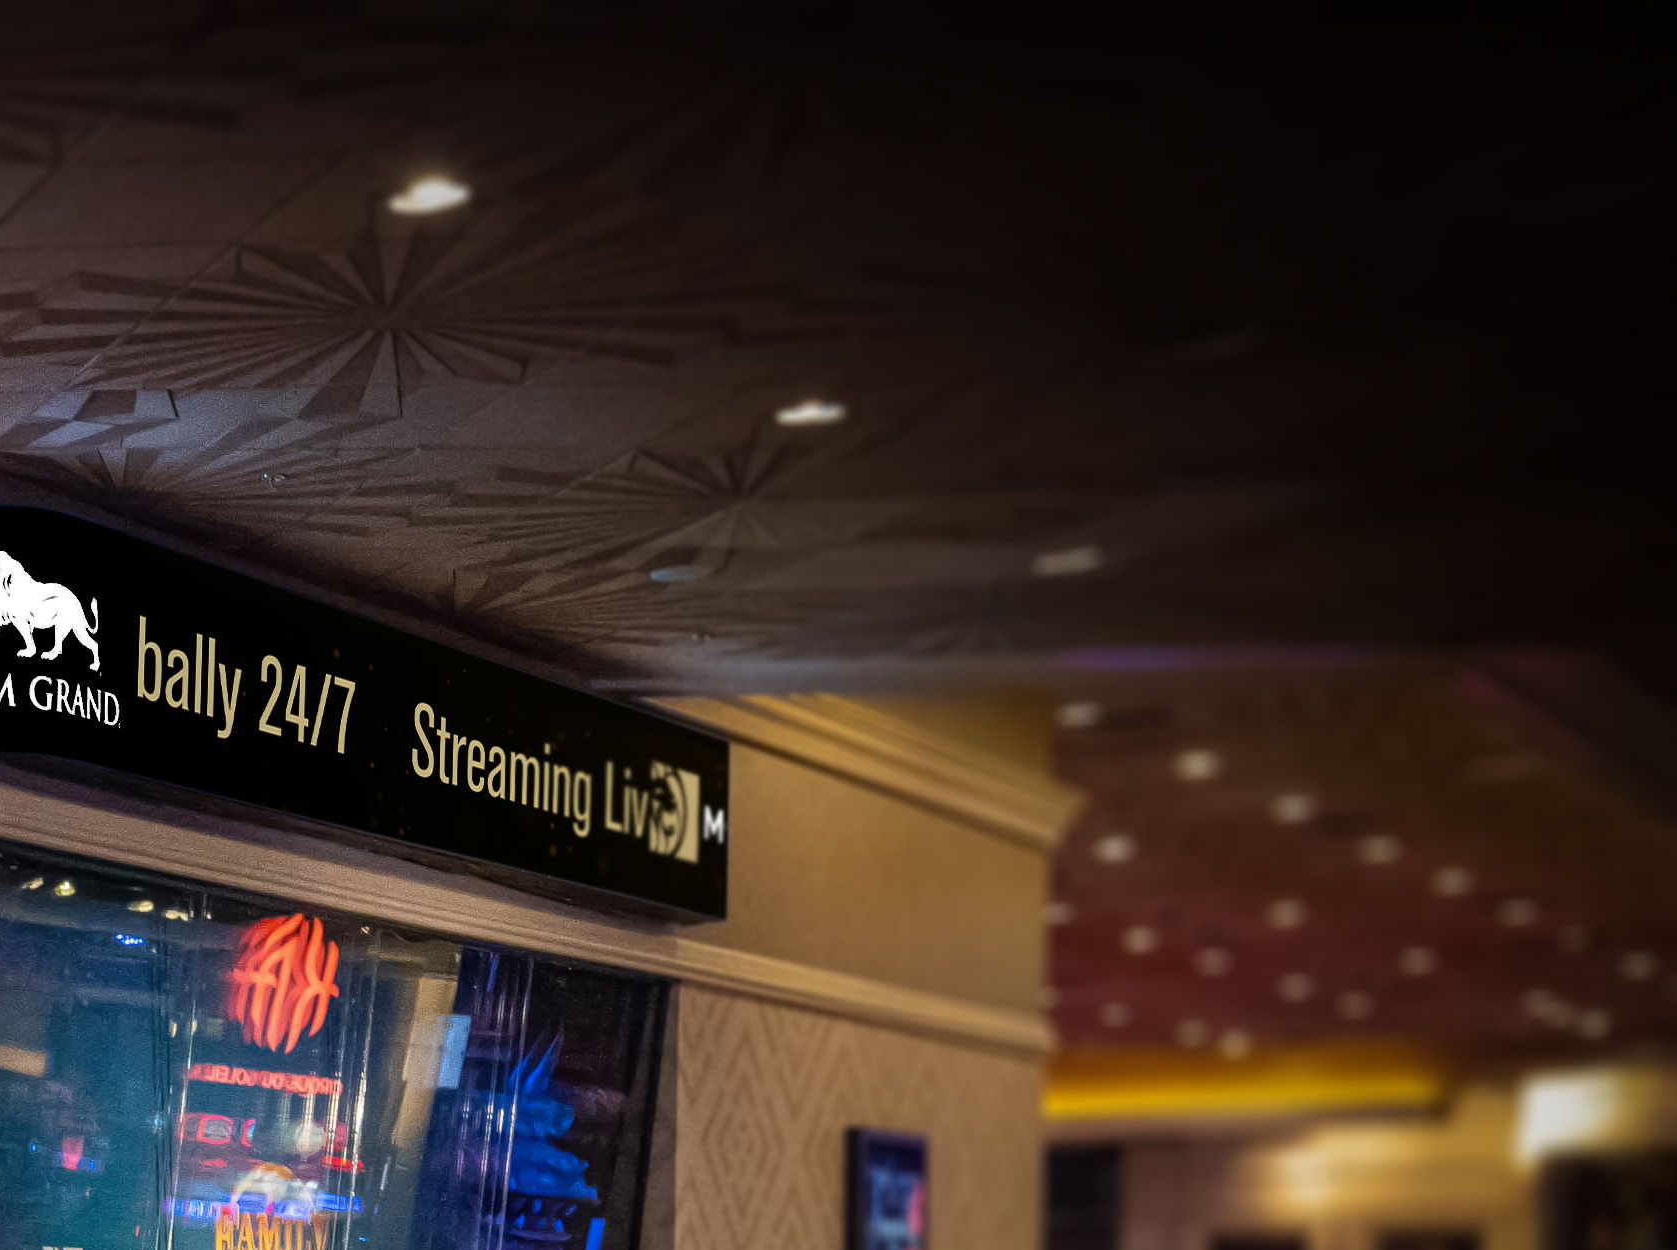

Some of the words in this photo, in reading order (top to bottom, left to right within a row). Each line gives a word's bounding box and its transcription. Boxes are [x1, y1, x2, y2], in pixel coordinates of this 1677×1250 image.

[28, 675, 121, 728] GRAND
[136, 615, 243, 739] bally
[258, 654, 357, 755] 24/7
[411, 701, 593, 838] Streaming
[604, 760, 649, 839] Liv
